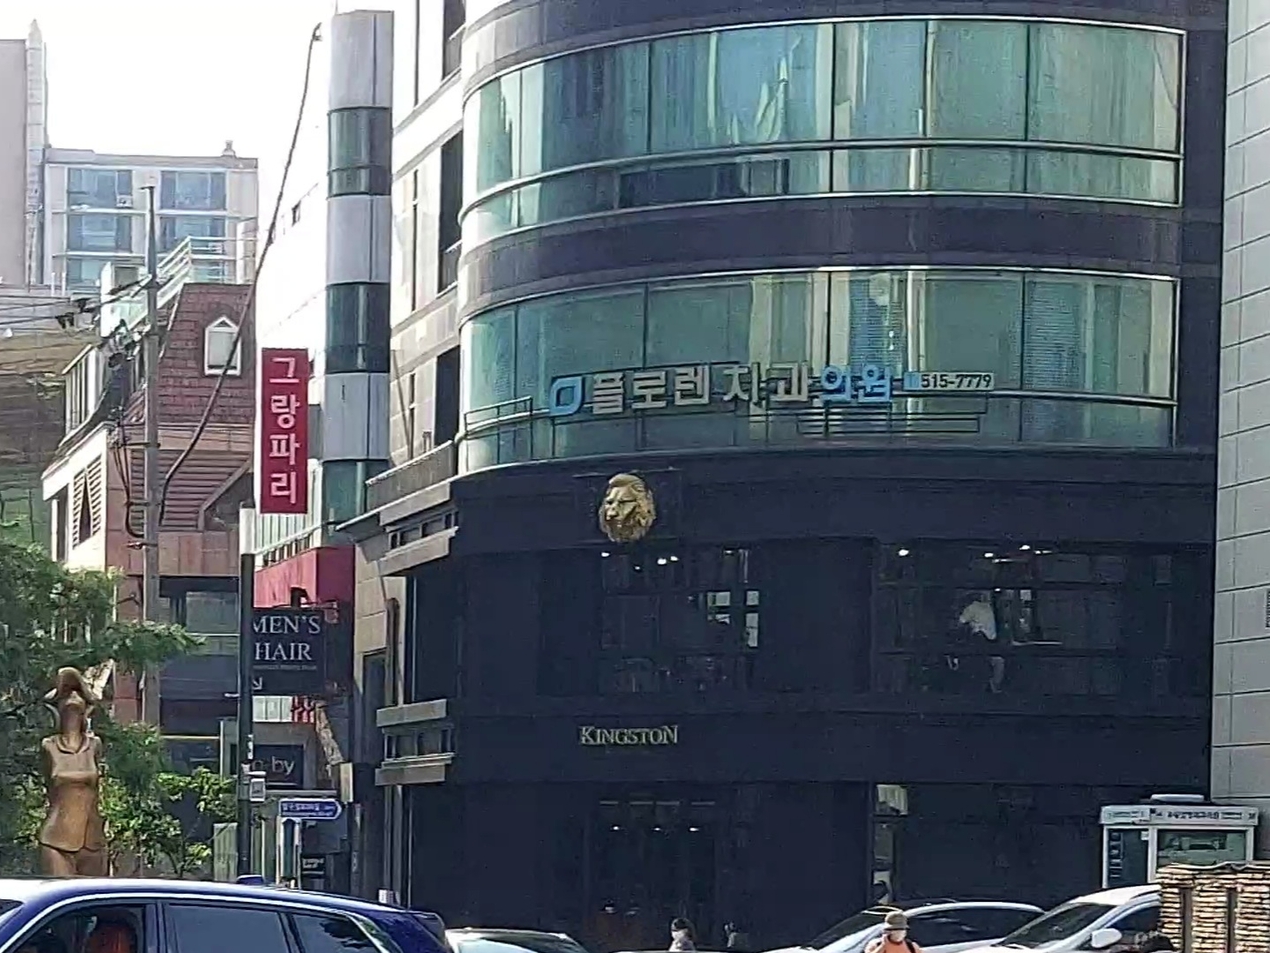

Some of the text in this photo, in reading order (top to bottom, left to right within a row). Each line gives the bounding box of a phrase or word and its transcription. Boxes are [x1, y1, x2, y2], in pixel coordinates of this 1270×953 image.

[921, 373, 992, 389] 515-7779
[269, 357, 300, 504] 그랑파리
[255, 642, 312, 660] HAIR
[578, 725, 679, 745] KINGSTON
